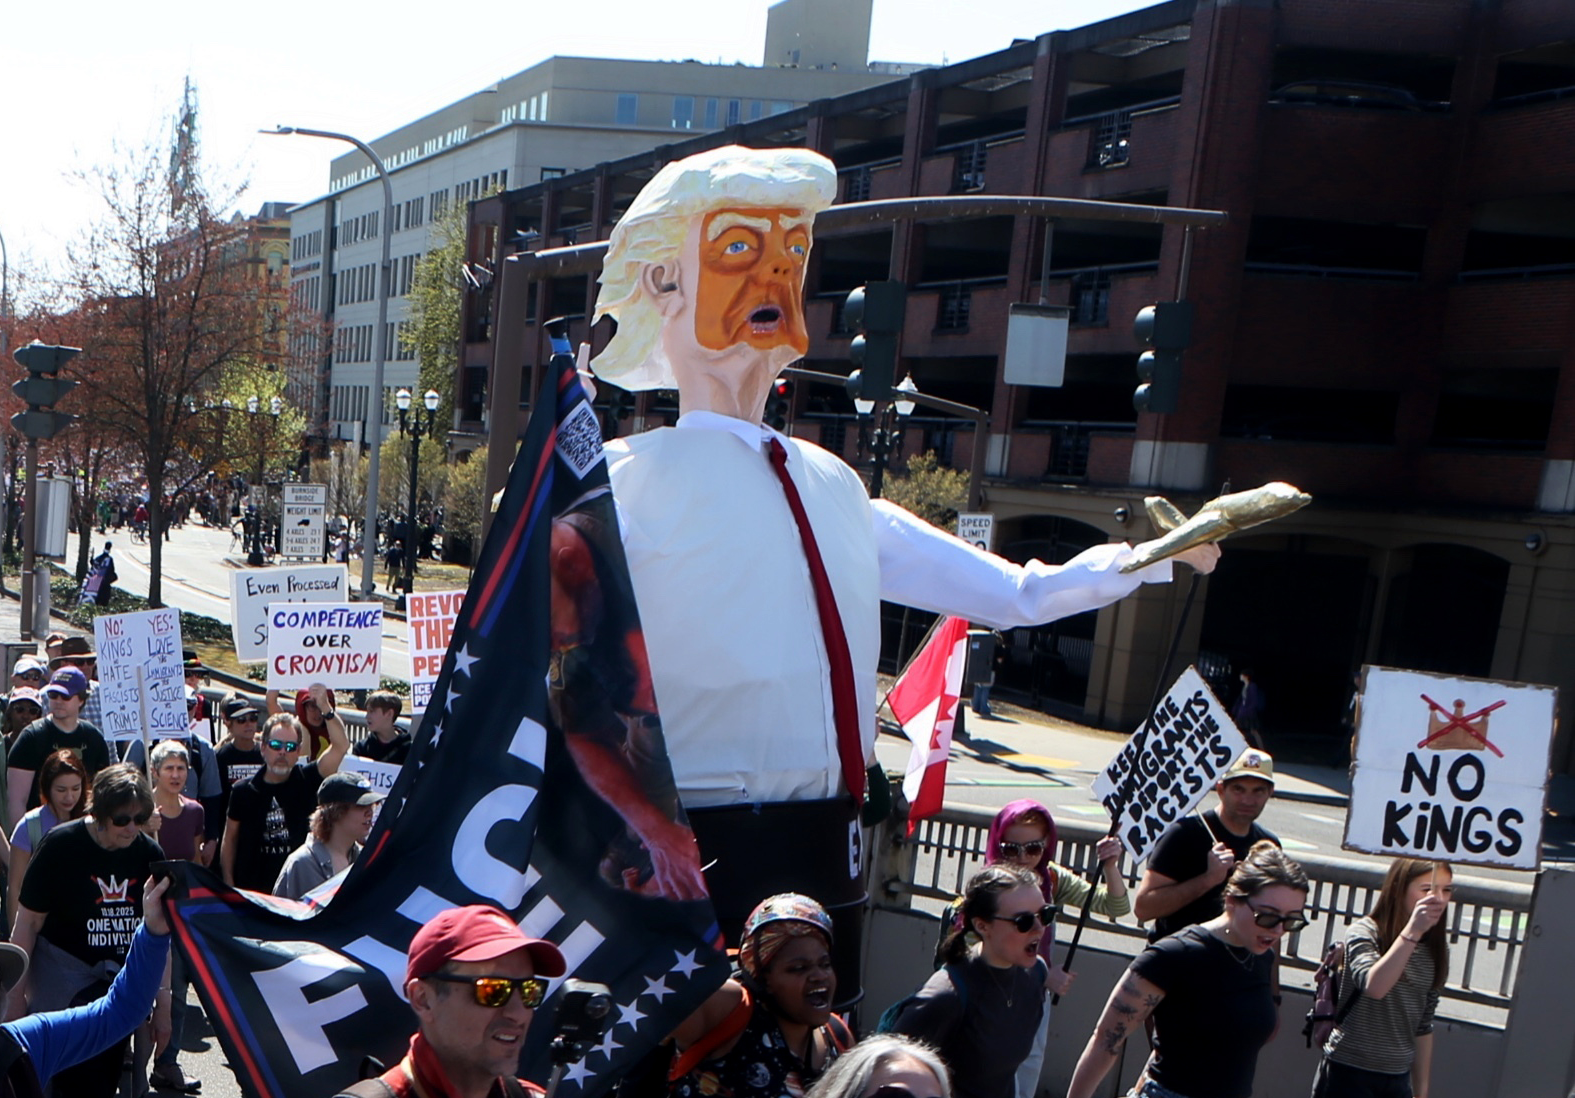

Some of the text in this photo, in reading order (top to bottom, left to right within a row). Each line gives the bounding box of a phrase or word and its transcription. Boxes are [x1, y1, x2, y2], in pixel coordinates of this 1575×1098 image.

[287, 507, 322, 516] WEIGHT LIMIT
[961, 518, 991, 527] SPEED
[963, 529, 986, 538] LIMIT
[246, 576, 340, 597] Even Processed
[410, 593, 464, 618] REVO
[104, 614, 174, 638] NO: YES:
[273, 608, 382, 630] COMPETENCE
[302, 634, 352, 649] OVER
[411, 619, 453, 650] THE
[100, 636, 175, 660] KINGS LOVE
[103, 665, 132, 682] HATE
[274, 652, 378, 676] CRONYISM
[104, 682, 183, 704] FASCISTS JUSTICE
[414, 684, 430, 694] ICE
[150, 707, 188, 730] SCIENCE
[1148, 696, 1180, 736] THE
[1129, 714, 1219, 823] DEPORT THE
[1400, 752, 1485, 802] NO
[1127, 735, 1232, 857] RACISTS
[87, 917, 141, 932] ONE NATIO
